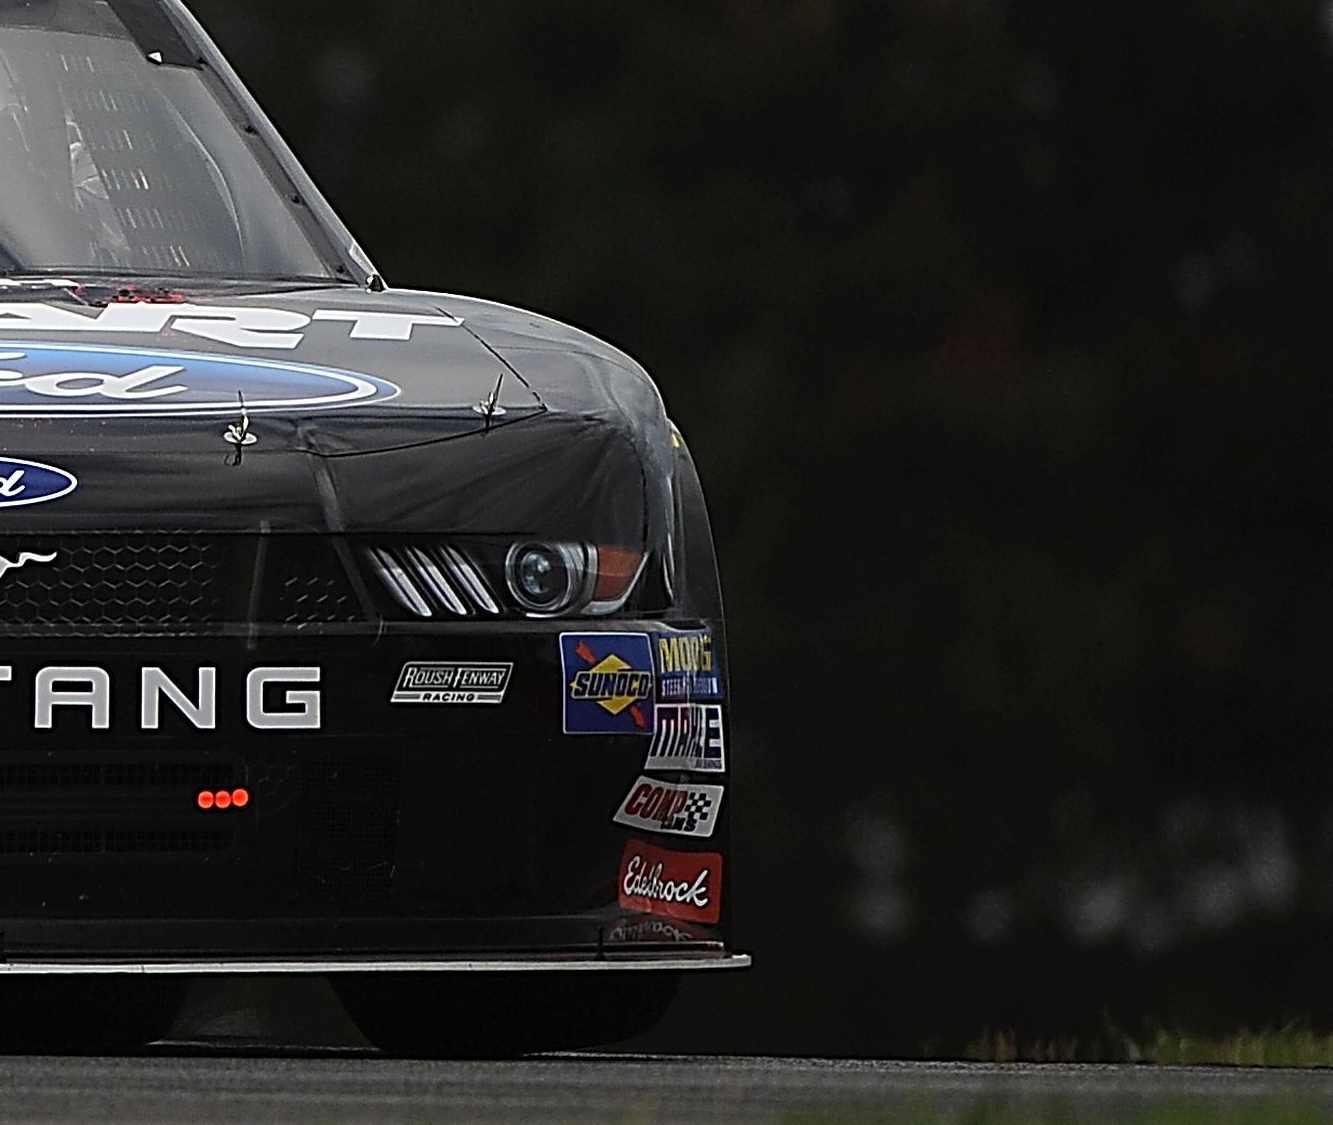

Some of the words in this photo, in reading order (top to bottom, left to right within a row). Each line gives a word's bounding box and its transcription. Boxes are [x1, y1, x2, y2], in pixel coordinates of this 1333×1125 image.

[403, 667, 454, 688] ROUSH
[452, 667, 508, 689] FENWAY
[574, 672, 652, 698] SUNOCO
[422, 692, 476, 702] RACING
[624, 783, 690, 822] COMP
[623, 856, 709, 907] Edelbrock
